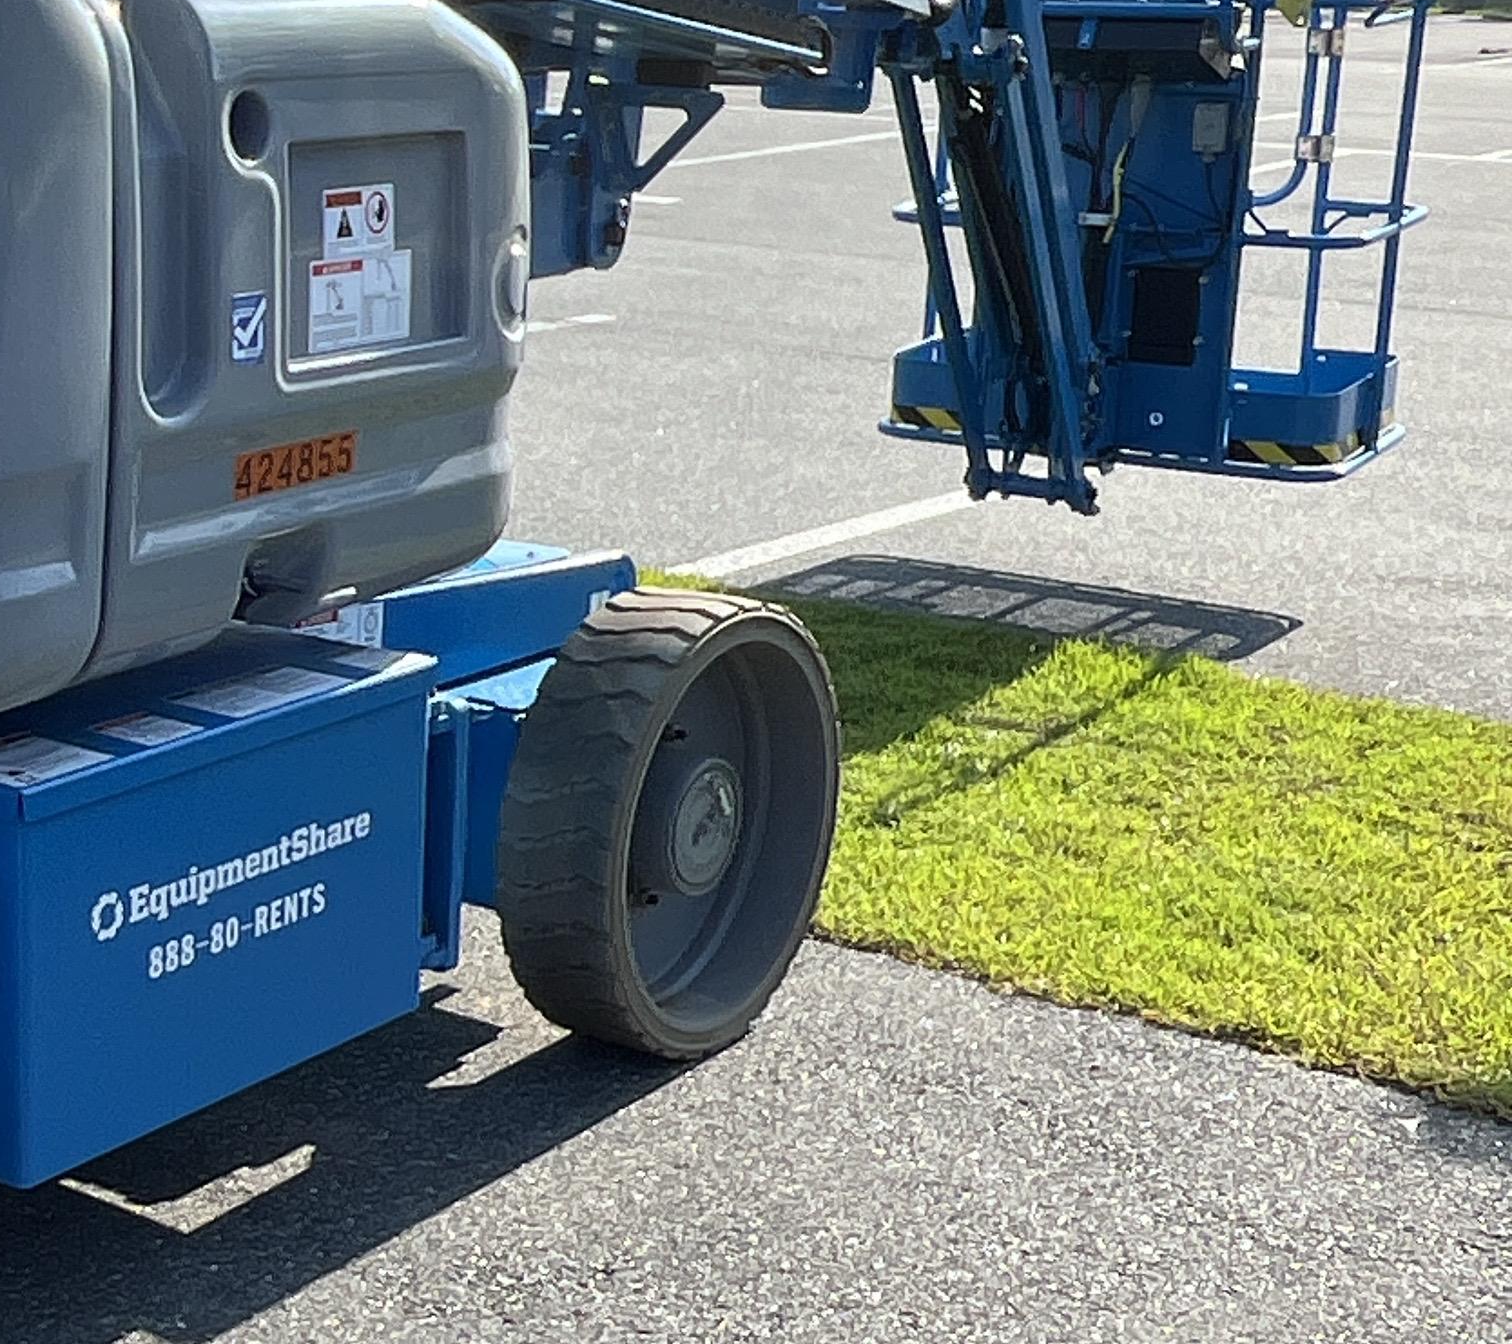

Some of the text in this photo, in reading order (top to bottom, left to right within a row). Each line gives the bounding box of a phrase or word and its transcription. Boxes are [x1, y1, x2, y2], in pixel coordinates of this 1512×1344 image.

[234, 433, 354, 498] 424855
[128, 810, 372, 923] EquipmentShare
[148, 882, 326, 979] 888-80-RENTS
